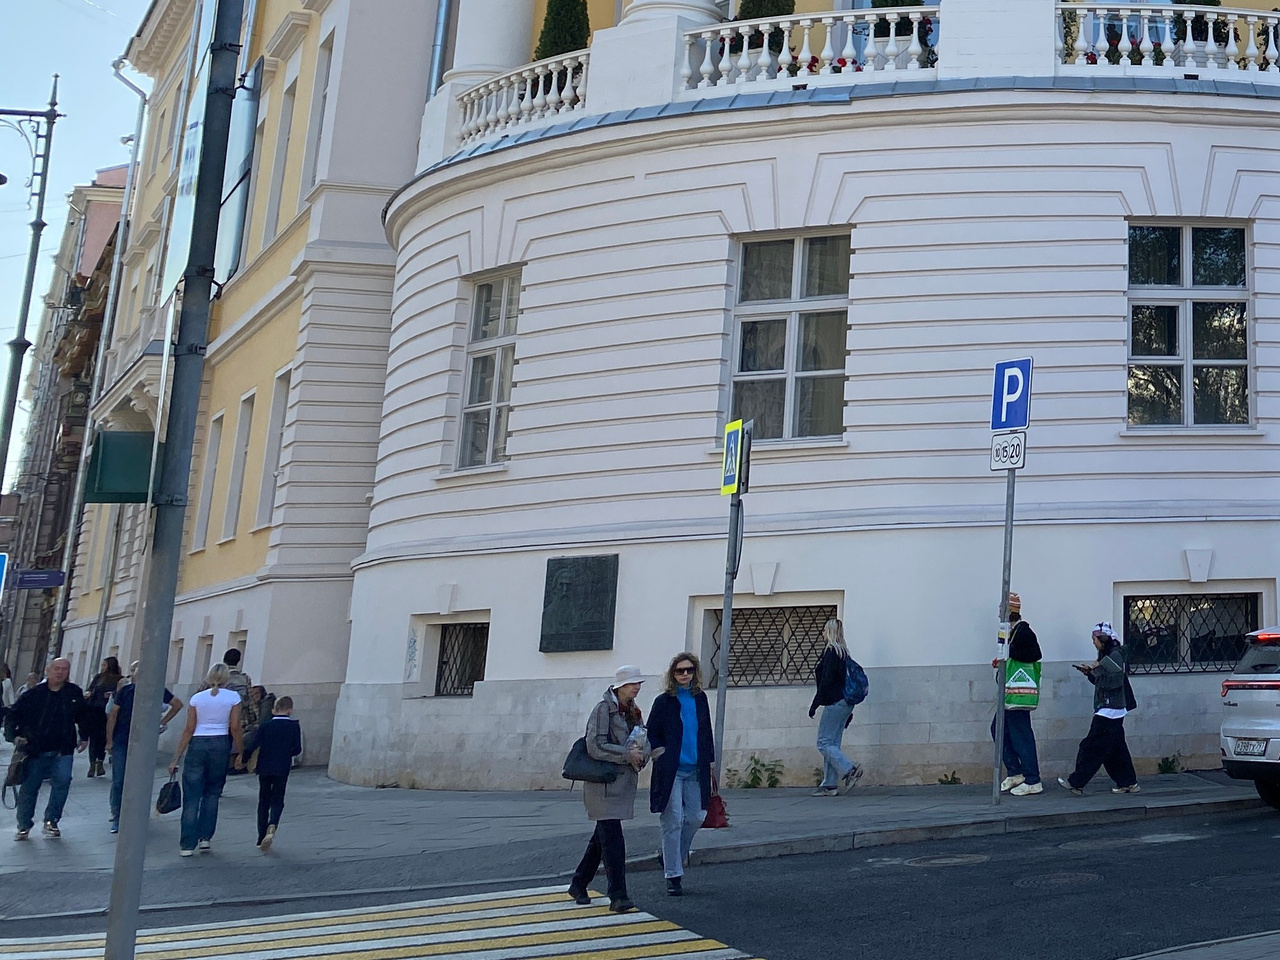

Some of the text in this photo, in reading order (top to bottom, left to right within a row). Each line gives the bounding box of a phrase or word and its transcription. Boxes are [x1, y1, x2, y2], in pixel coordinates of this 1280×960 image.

[1001, 367, 1024, 422] P
[1002, 445, 1008, 458] 15
[1010, 443, 1020, 458] 20
